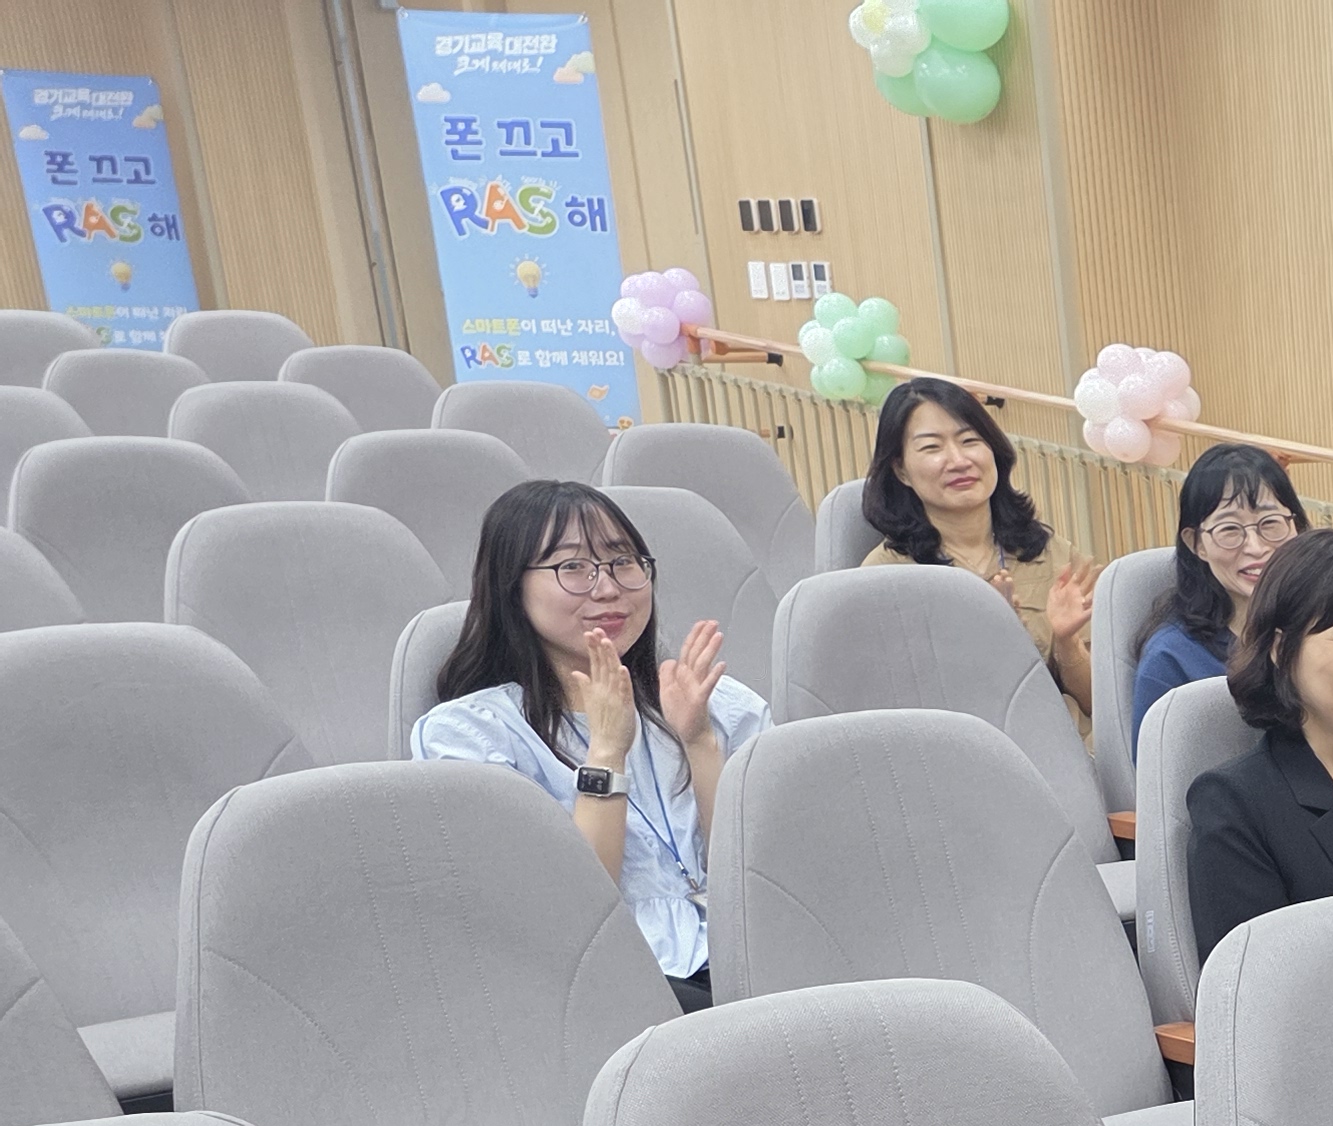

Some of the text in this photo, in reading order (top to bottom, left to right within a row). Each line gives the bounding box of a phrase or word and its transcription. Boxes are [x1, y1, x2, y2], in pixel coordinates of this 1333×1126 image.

[435, 32, 503, 56] 경기교육
[444, 116, 580, 160] 폰 끄고
[44, 150, 156, 185] 폰 끄고
[42, 202, 180, 243] RAS 해
[439, 183, 608, 237] RAS 해
[462, 319, 537, 336] 스마트폰이
[541, 319, 573, 336] 떠난
[460, 343, 514, 369] RAS
[535, 350, 569, 367] 함께
[572, 350, 625, 366] 채워요!
